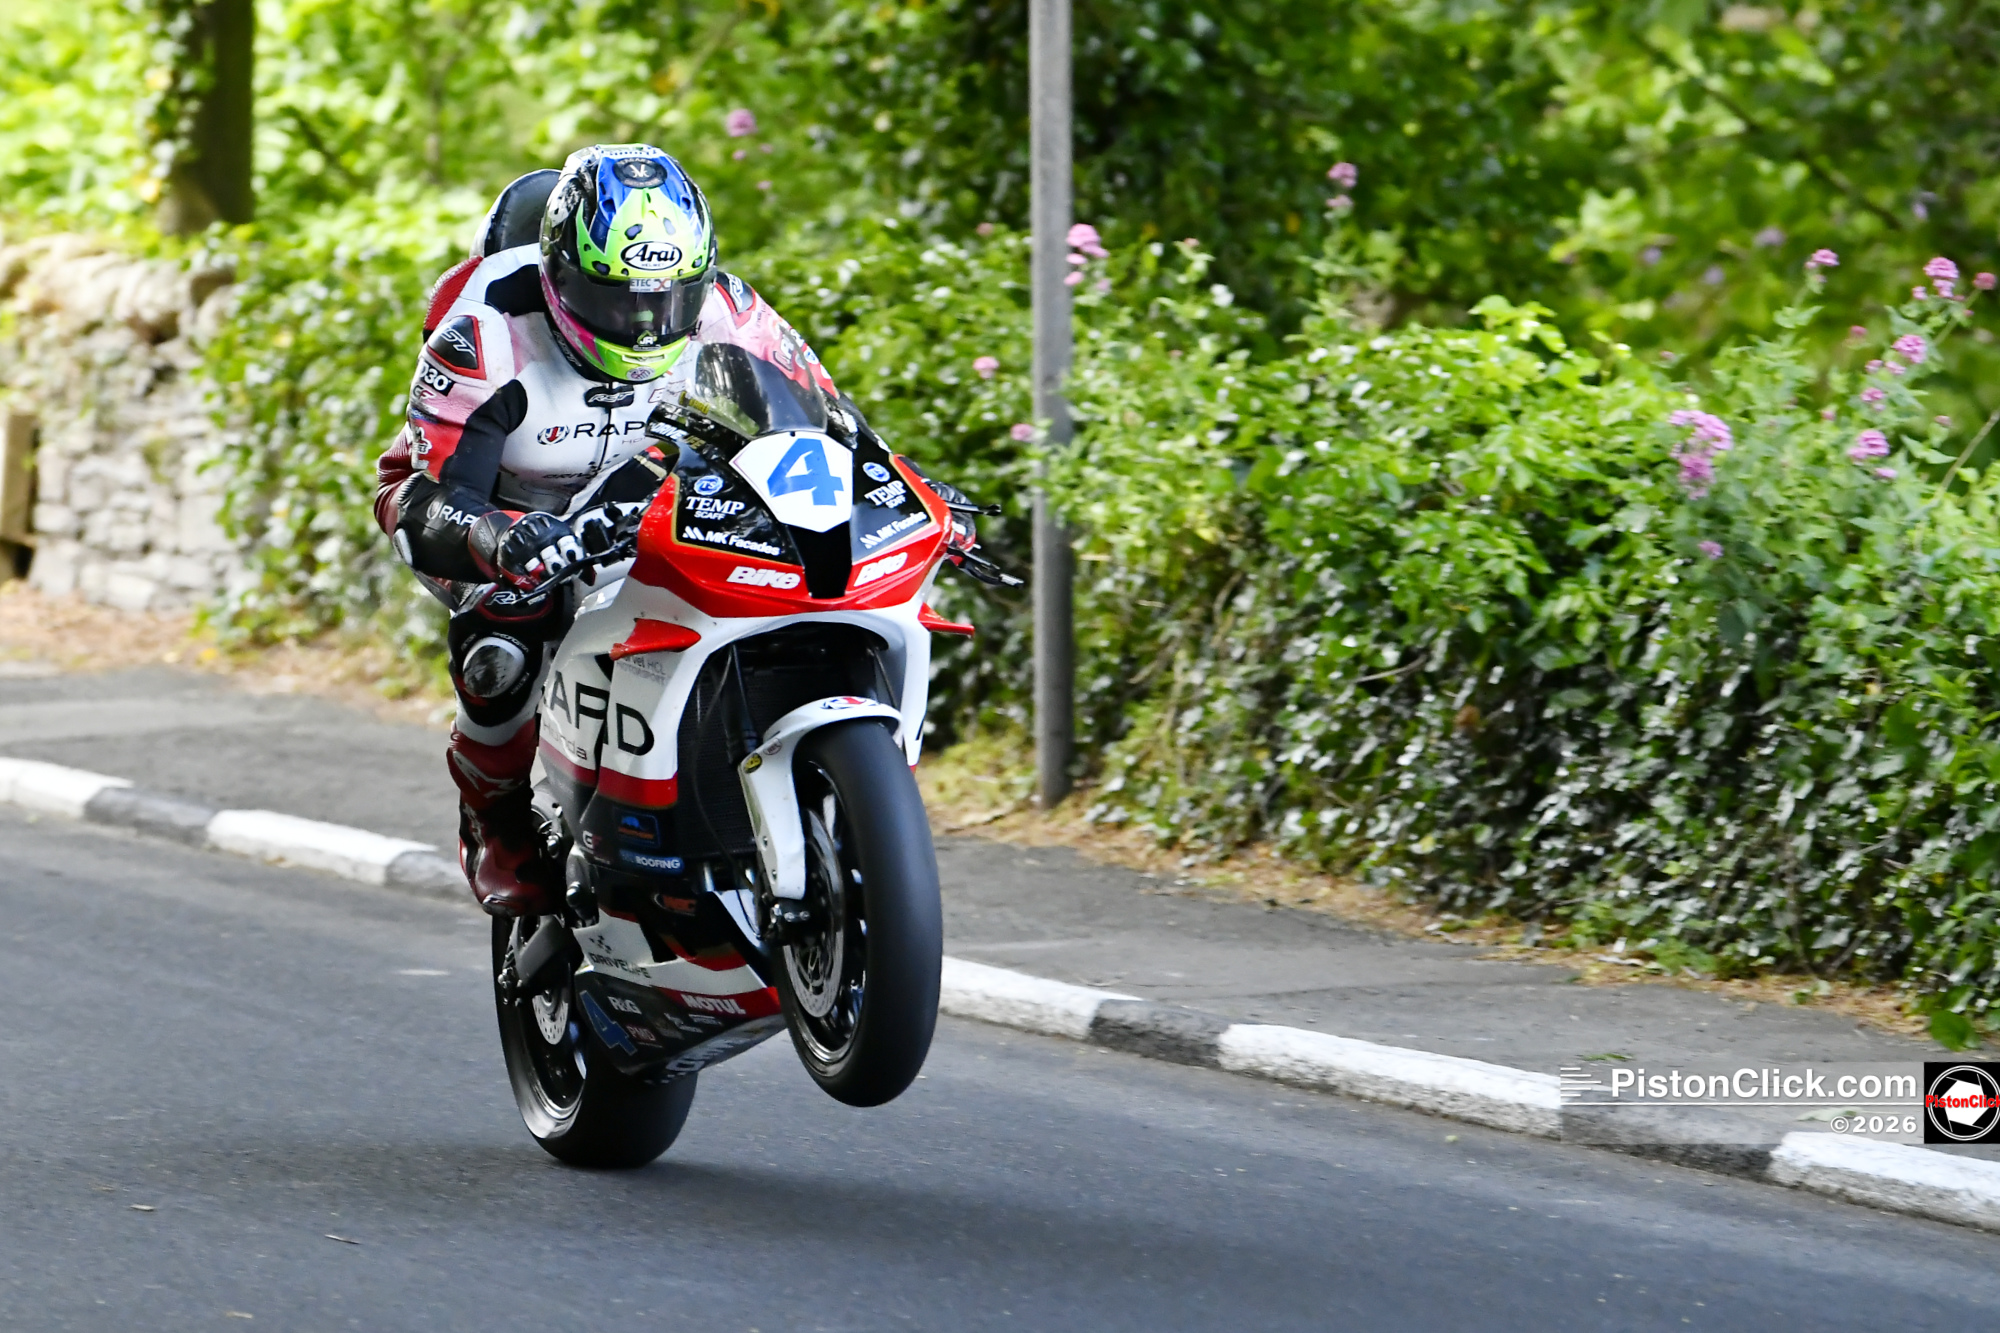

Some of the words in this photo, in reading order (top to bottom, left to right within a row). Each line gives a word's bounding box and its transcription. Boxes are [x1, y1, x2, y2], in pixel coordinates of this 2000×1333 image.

[624, 244, 678, 262] Arai
[440, 327, 477, 358] ST
[587, 390, 635, 403] RST
[573, 420, 645, 439] RAP
[766, 437, 848, 507] 4
[701, 480, 717, 490] TS
[863, 480, 907, 507] TEMP
[438, 504, 481, 528] RAP
[685, 496, 746, 516] TEMP
[694, 511, 726, 521] SCAFF
[704, 530, 729, 545] MK
[727, 535, 782, 557] Facades
[606, 995, 643, 1015] R&G
[679, 993, 747, 1015] MOTUL
[579, 989, 639, 1057] 4
